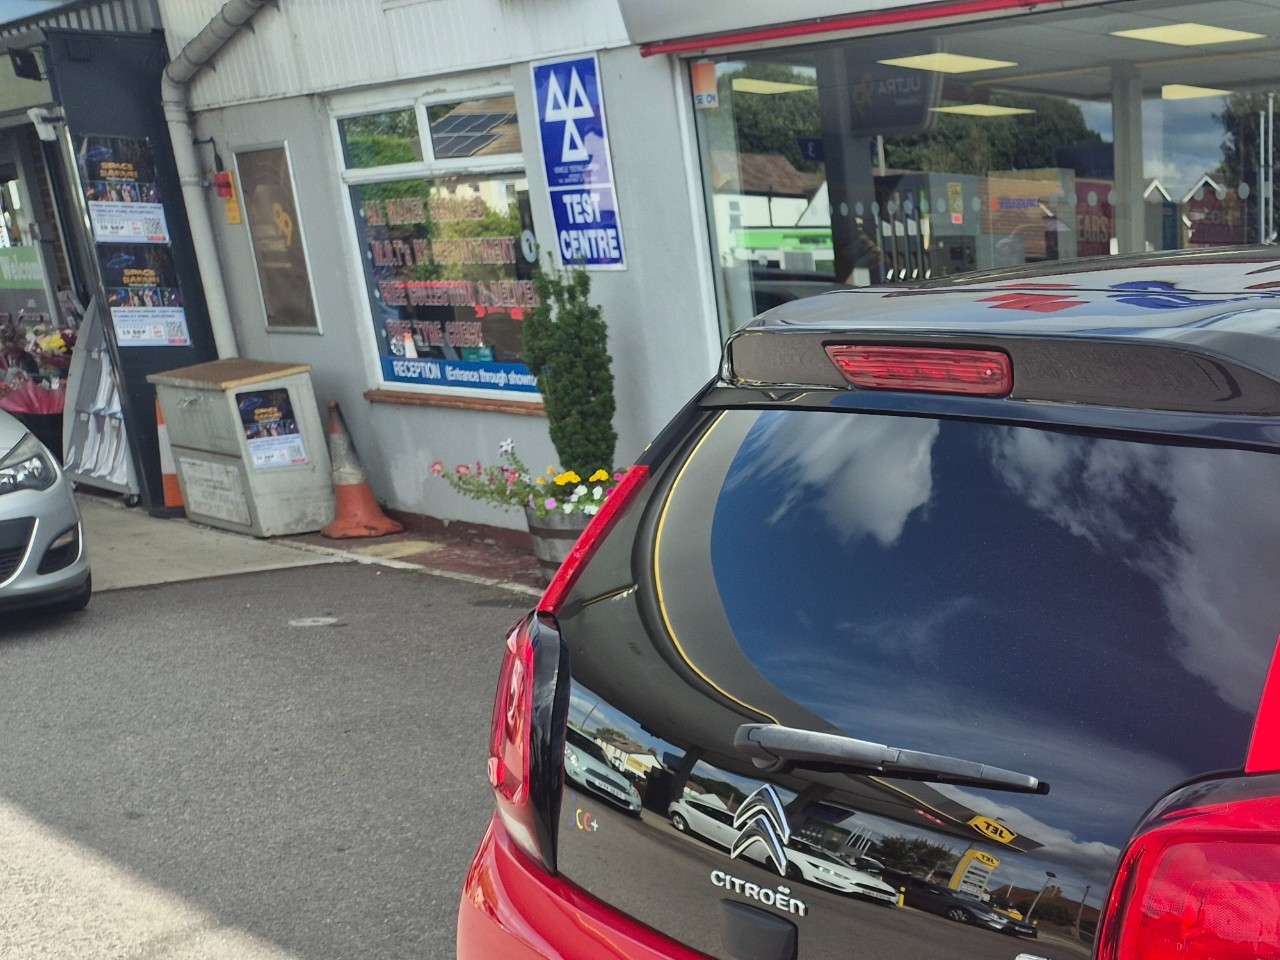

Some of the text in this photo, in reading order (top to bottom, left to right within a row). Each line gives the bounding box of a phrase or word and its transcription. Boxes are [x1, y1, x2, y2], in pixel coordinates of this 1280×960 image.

[563, 193, 602, 224] TEST
[560, 228, 620, 260] CENTRE
[393, 360, 441, 380] RECEPTION
